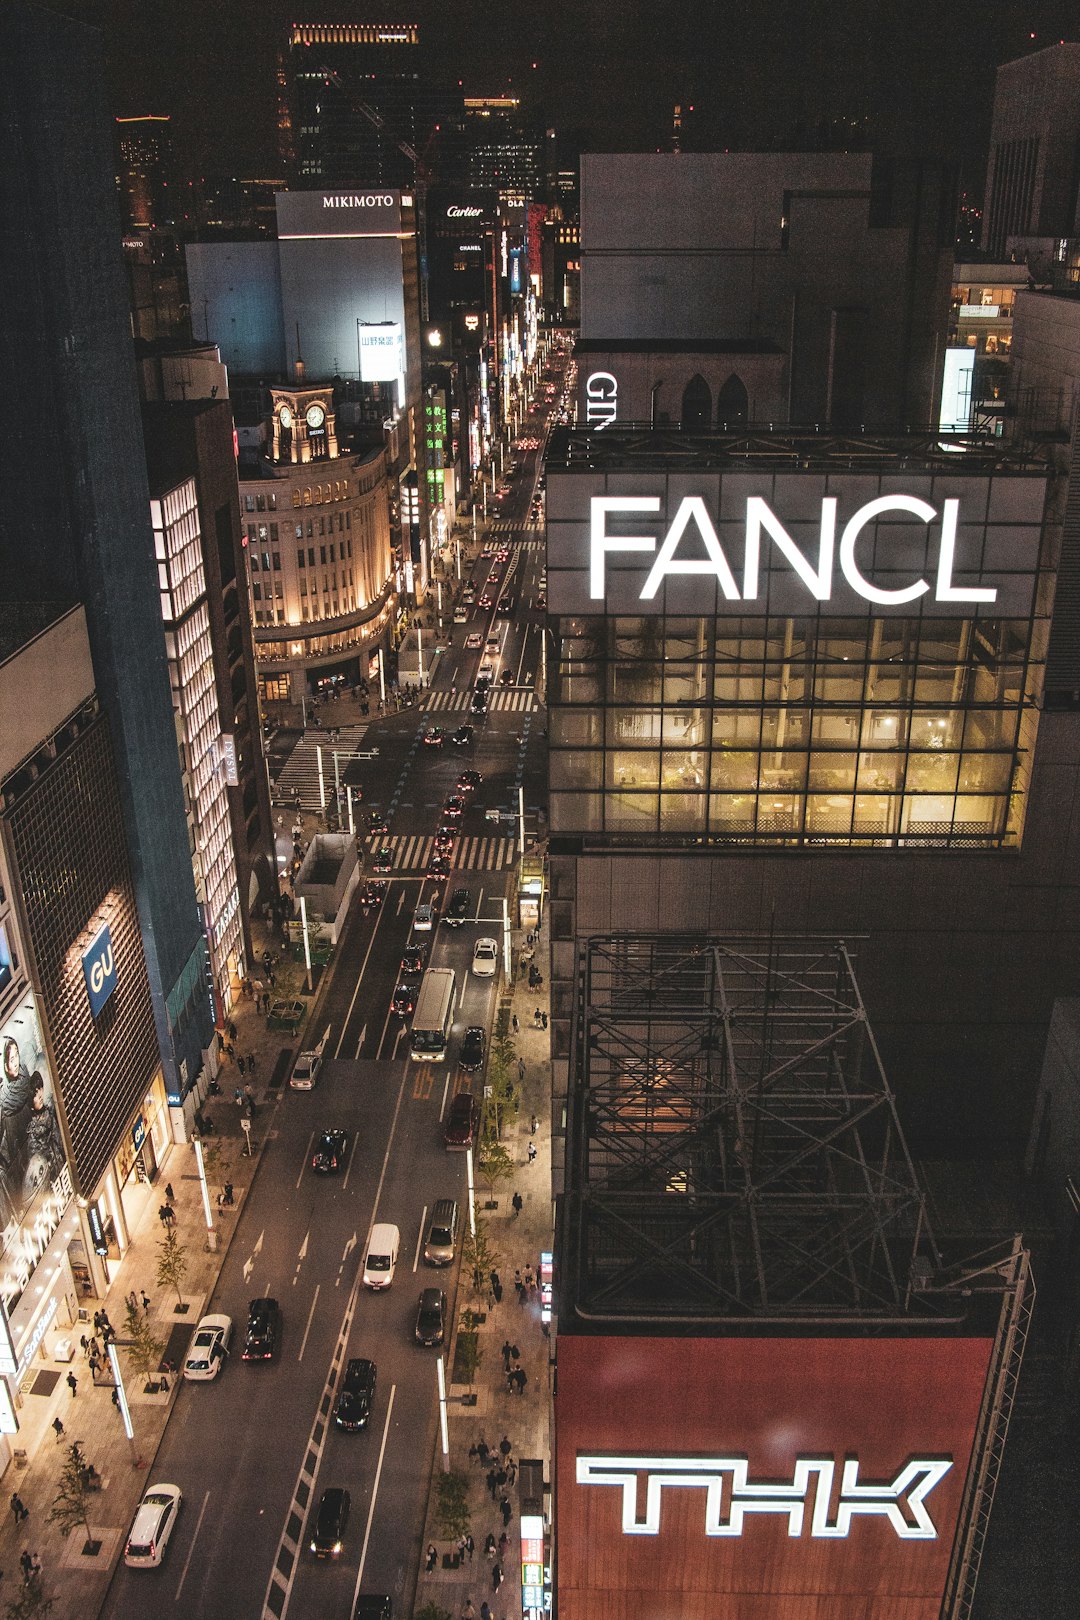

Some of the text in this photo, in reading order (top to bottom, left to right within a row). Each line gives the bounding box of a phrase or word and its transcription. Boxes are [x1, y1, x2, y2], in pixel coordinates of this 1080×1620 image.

[323, 195, 393, 208] MIKIMOTO
[447, 205, 483, 217] Cartier
[590, 494, 998, 605] FANCL
[224, 741, 236, 780] TASAKI
[214, 886, 240, 947] TASAKI
[91, 943, 113, 993] GU
[168, 1095, 180, 1103] GU
[134, 1121, 144, 1143] GU
[576, 1456, 953, 1539] THK
